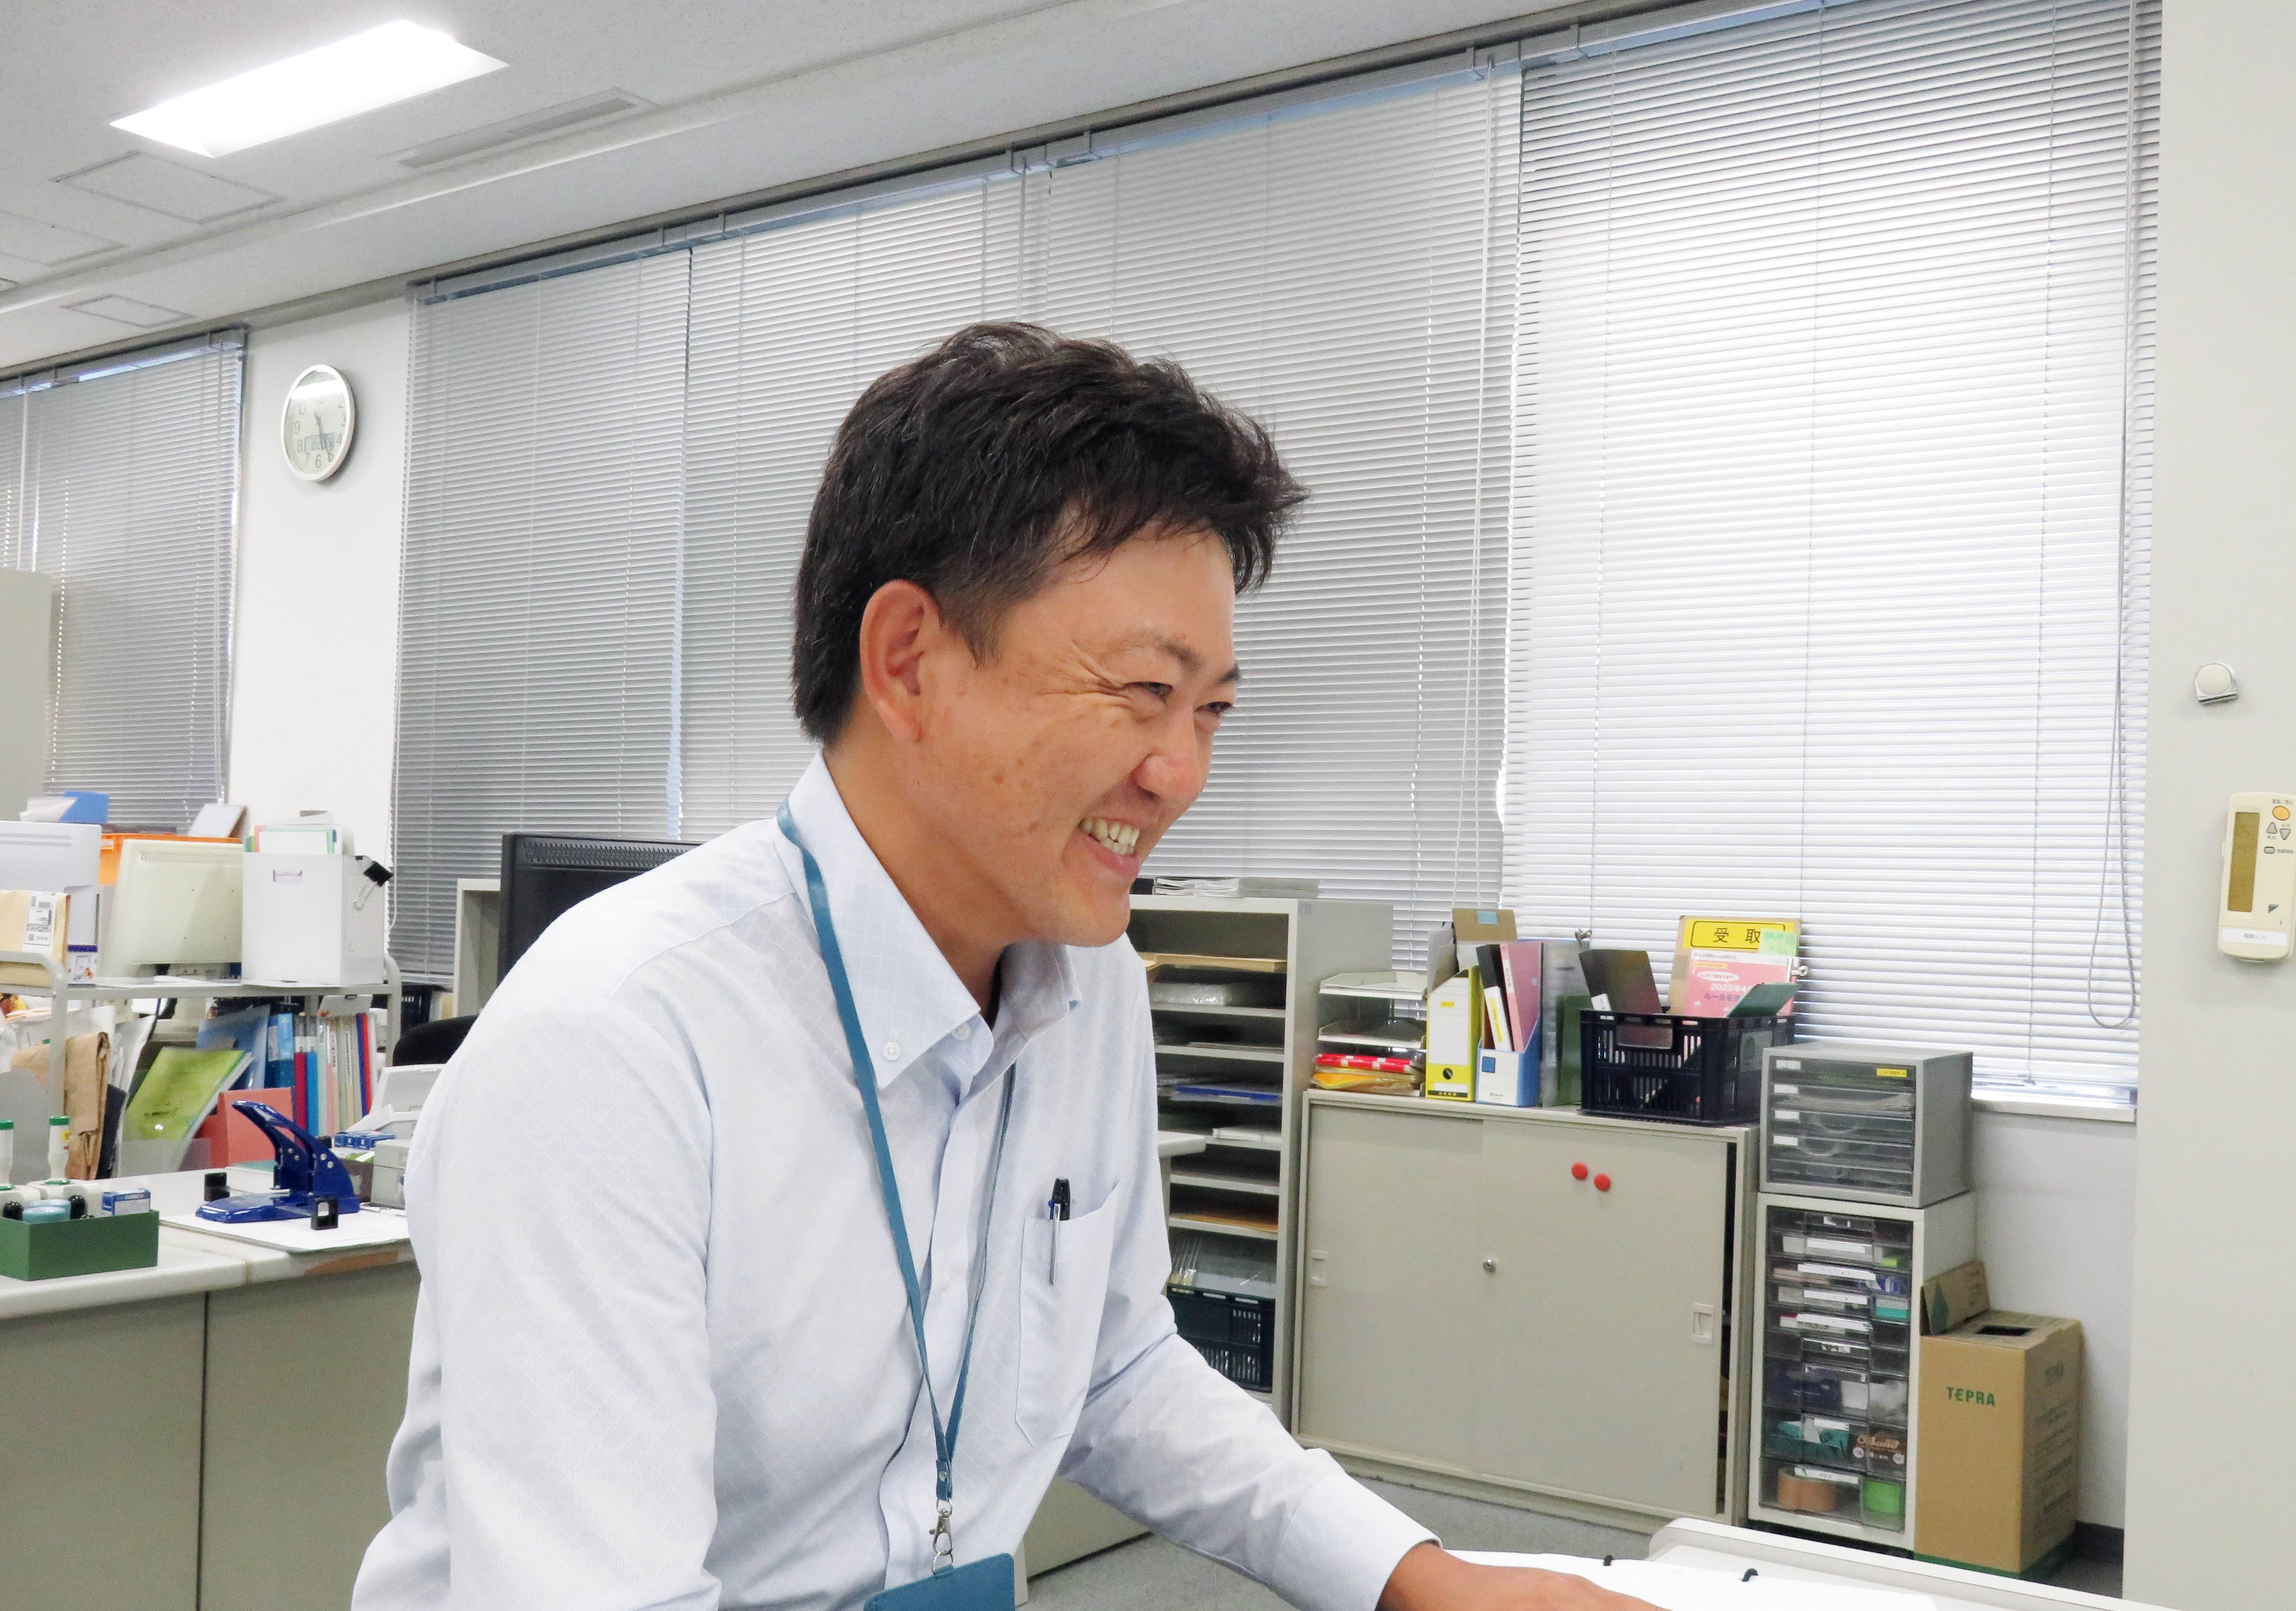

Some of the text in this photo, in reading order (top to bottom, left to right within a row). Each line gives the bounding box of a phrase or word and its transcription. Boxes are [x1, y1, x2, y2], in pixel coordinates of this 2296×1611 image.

[341, 413, 346, 427] 3
[294, 421, 301, 434] 9
[337, 433, 342, 444] 4
[297, 439, 303, 452] 8
[305, 453, 310, 465] 7
[315, 454, 322, 468] 6
[1946, 1386, 1995, 1406] TEPRA
